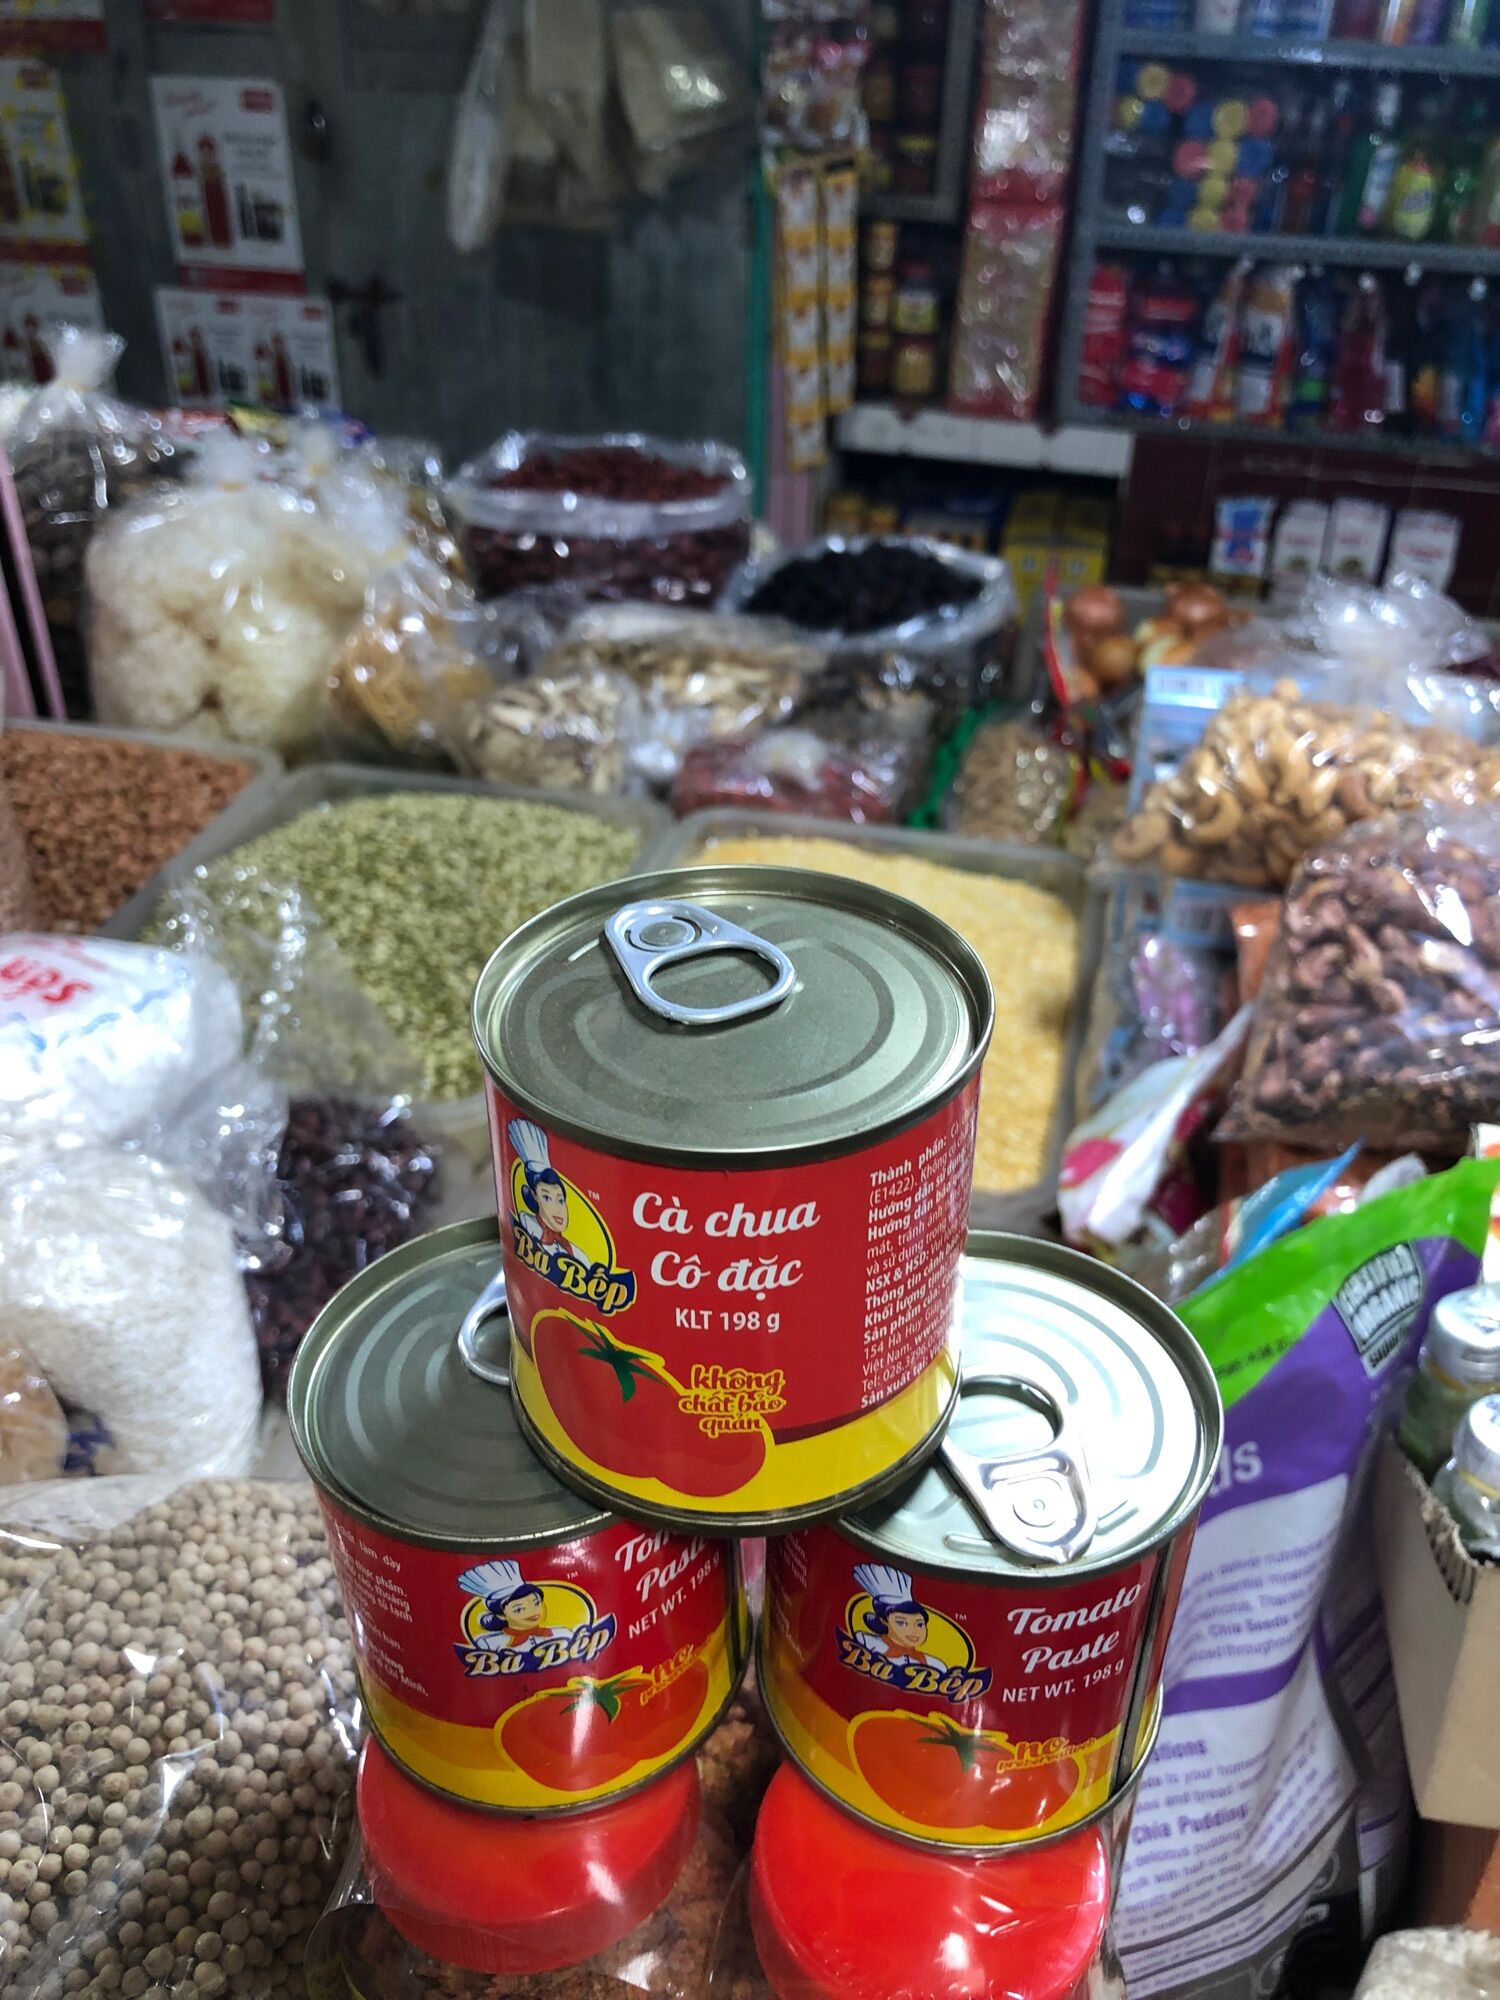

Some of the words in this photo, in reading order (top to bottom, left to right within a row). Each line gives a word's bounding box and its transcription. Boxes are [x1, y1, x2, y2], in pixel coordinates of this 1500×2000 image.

[869, 1174, 917, 1207] (E1422).
[870, 1159, 912, 1187] Thành
[632, 1192, 694, 1235] Cà
[704, 1201, 821, 1238] chua
[868, 1214, 911, 1242] Hướng
[869, 1196, 912, 1224] Hướng
[898, 1221, 926, 1246] tránh
[513, 1226, 551, 1275] Bà
[557, 1256, 628, 1311] Bếp
[651, 1251, 711, 1290] Cô
[717, 1254, 804, 1301] đặc
[866, 1260, 880, 1277] và
[866, 1271, 891, 1294] NSX
[893, 1266, 903, 1282] &
[905, 1249, 929, 1276] HSD:
[864, 1284, 905, 1311] Thông
[907, 1272, 922, 1290] tin
[675, 1307, 713, 1330] KLT
[719, 1311, 760, 1331] 198
[766, 1311, 781, 1333] g
[864, 1302, 894, 1329] Khối
[864, 1324, 888, 1345] Sản
[864, 1341, 884, 1360] 154
[888, 1332, 901, 1349] Hà
[905, 1319, 924, 1338] Huy
[862, 1354, 884, 1377] Việt
[886, 1343, 912, 1365] Nam.
[692, 1364, 785, 1396] không
[861, 1374, 881, 1392] Tel:
[861, 1389, 884, 1409] Sản
[628, 1607, 658, 1640] NET
[660, 1587, 687, 1617] WT.
[690, 1561, 712, 1591] 198
[1007, 1583, 1146, 1636] Tomato
[465, 1649, 526, 1676] Bà
[530, 1625, 610, 1668] Bếp
[1021, 1630, 1120, 1674] Paste
[842, 1640, 894, 1680] Bà
[905, 1664, 984, 1701] Bếp
[1002, 1685, 1040, 1703] NET
[1044, 1680, 1075, 1699] WT.
[1083, 1664, 1111, 1689] 198
[1115, 1658, 1125, 1677] g
[1131, 1820, 1171, 1845] Chia
[1177, 1803, 1249, 1835] Pudding
